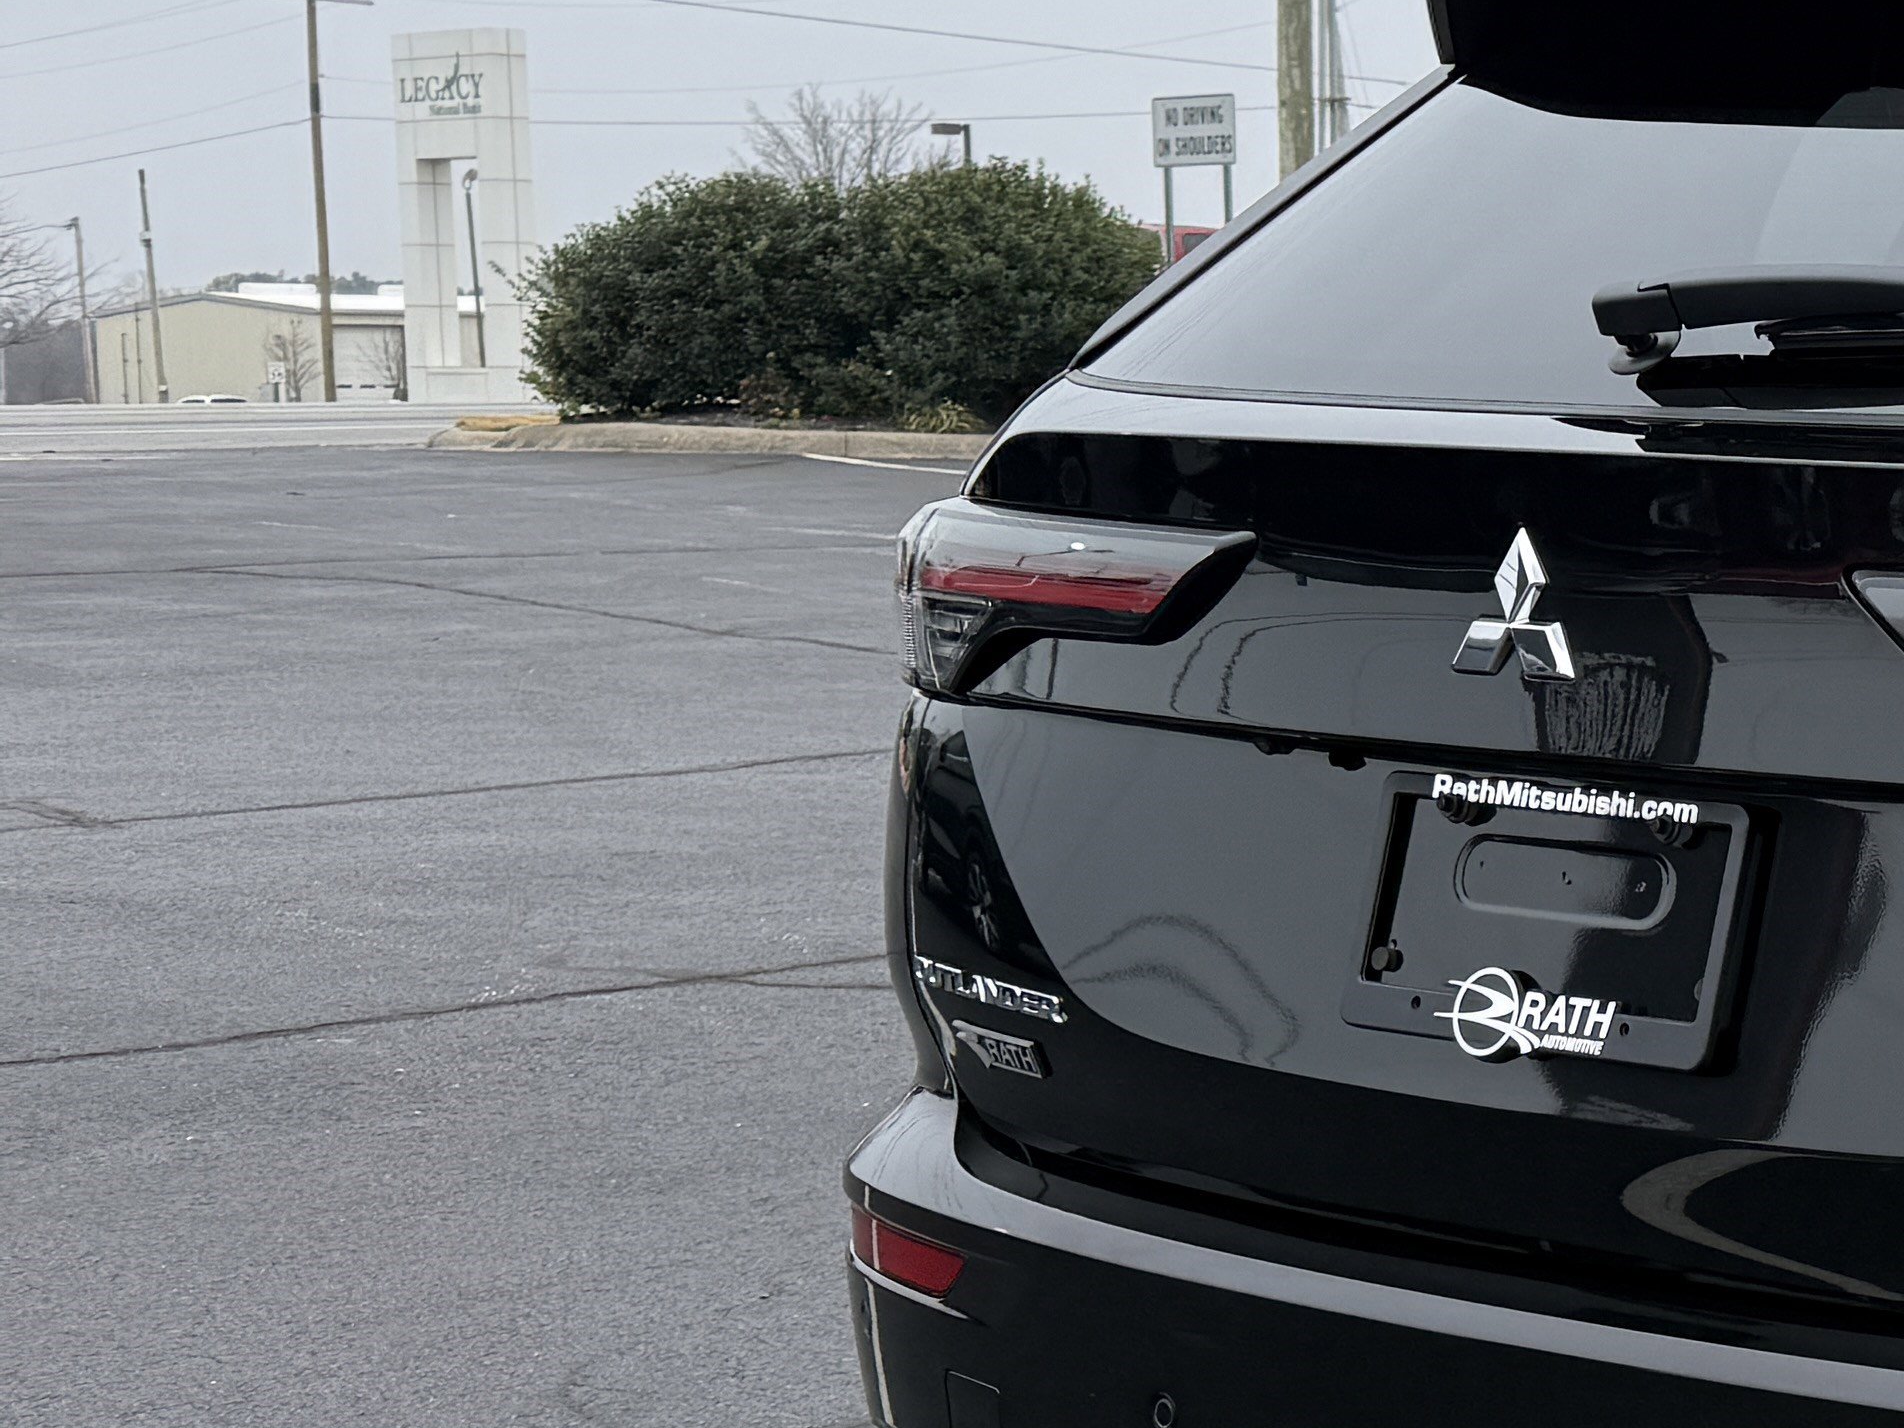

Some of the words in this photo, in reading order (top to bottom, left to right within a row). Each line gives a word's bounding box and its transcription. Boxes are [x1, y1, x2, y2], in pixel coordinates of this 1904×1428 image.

[400, 52, 483, 103] LEGACY
[1165, 108, 1178, 127] NO
[1183, 105, 1224, 125] DRIVING
[1158, 138, 1170, 157] ON
[1175, 134, 1233, 156] SHOULDERS
[1432, 774, 1699, 824] RathMitsubishi.com
[1517, 991, 1616, 1039] RATH
[984, 1038, 1039, 1073] RATH
[1540, 1033, 1604, 1056] AUTOMOTIVE
